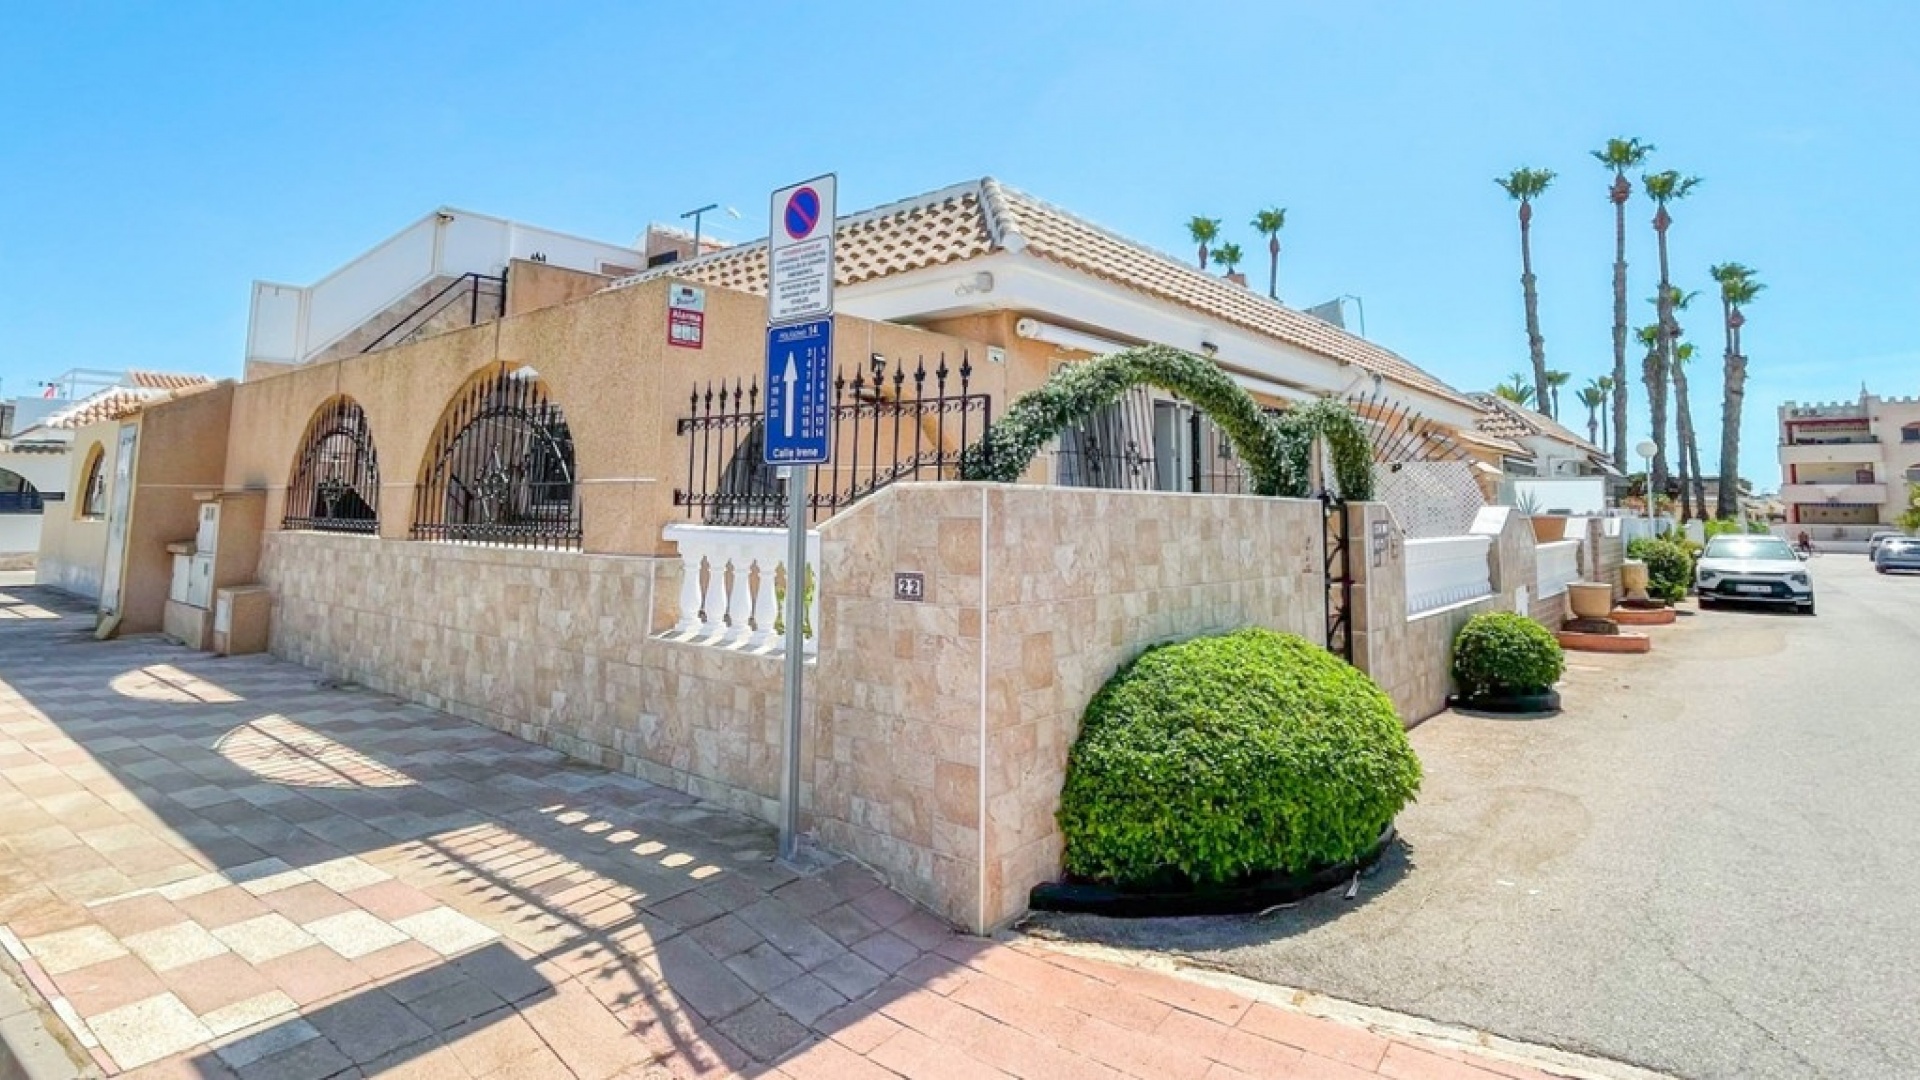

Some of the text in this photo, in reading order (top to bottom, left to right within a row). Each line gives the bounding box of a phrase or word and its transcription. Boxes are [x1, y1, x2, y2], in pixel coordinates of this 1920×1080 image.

[773, 447, 818, 458] Calle Irene
[899, 579, 918, 595] 22
